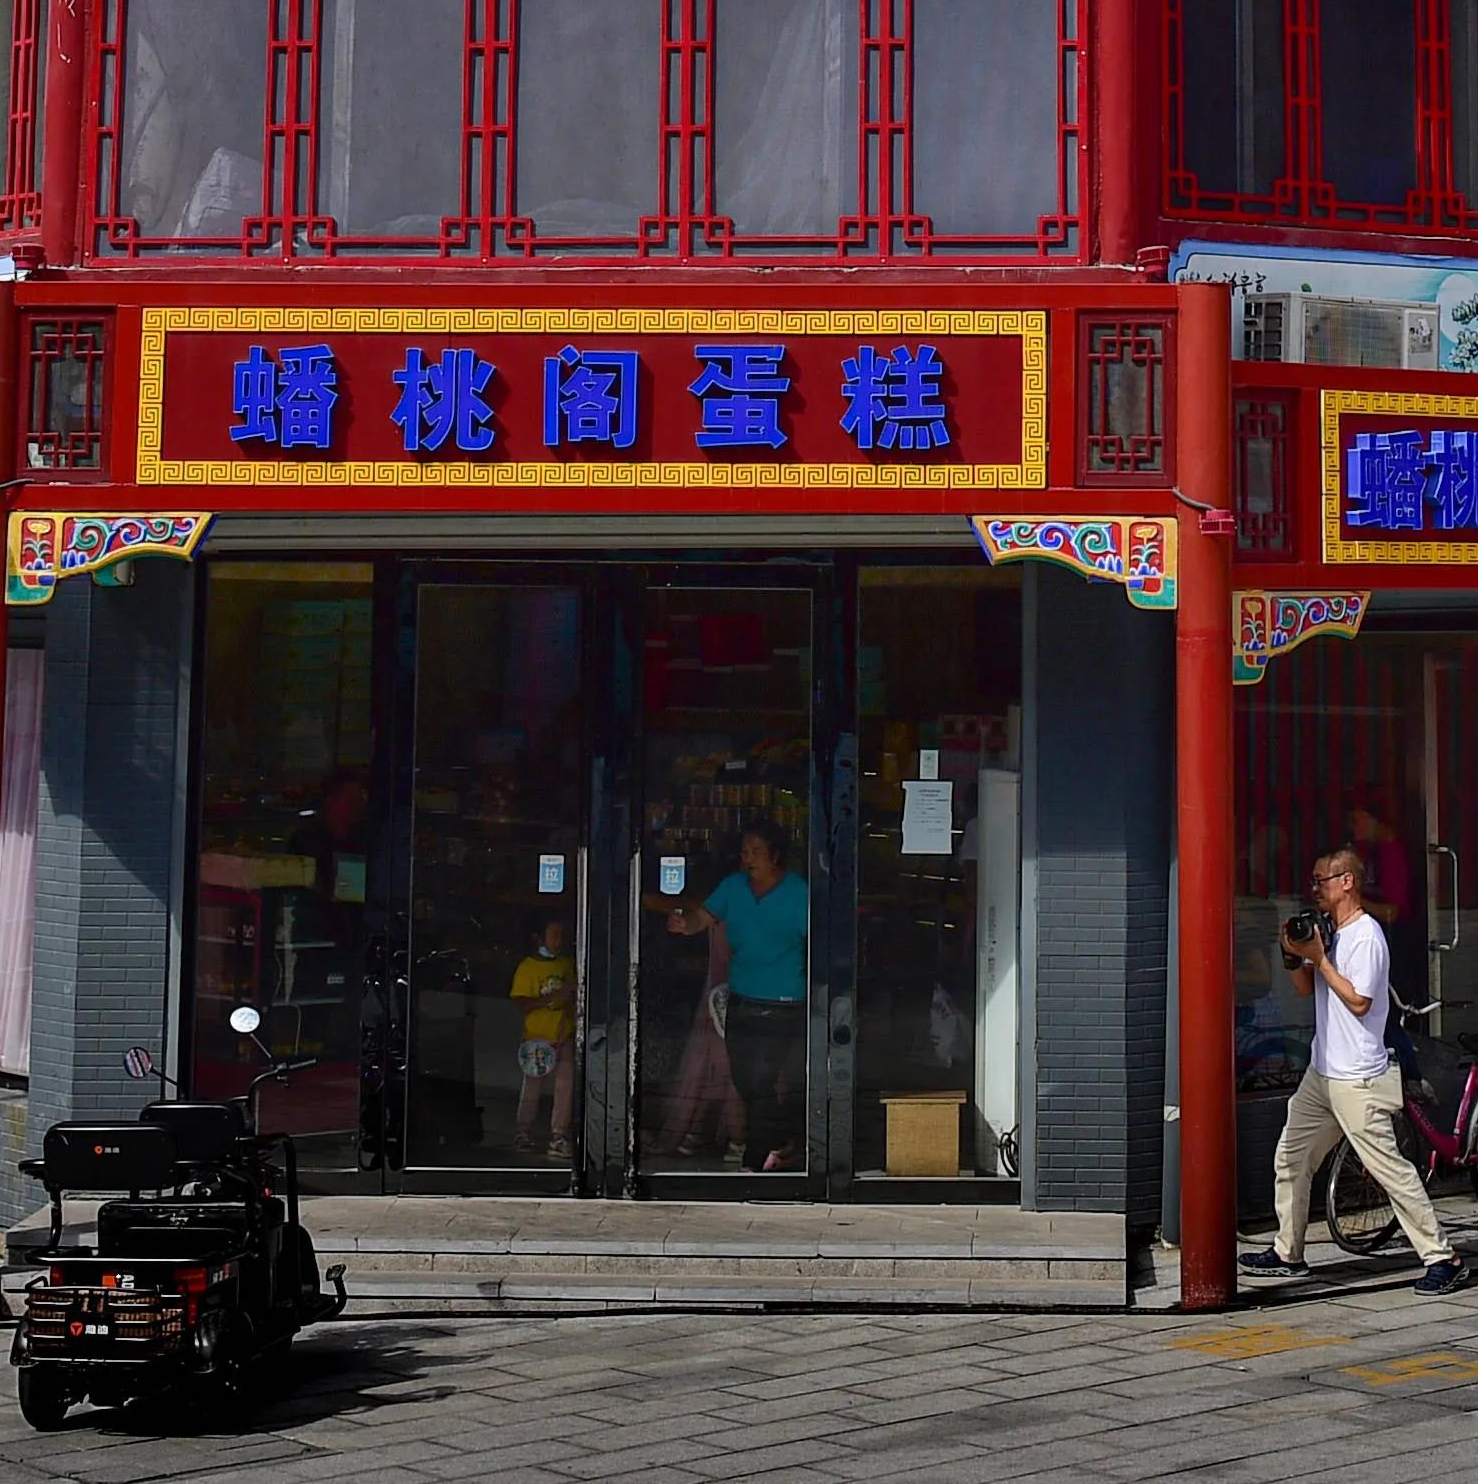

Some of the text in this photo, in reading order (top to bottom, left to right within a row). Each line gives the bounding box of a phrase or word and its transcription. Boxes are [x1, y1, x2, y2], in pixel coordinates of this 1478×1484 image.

[229, 344, 951, 452] 蟠桃阁蛋糕
